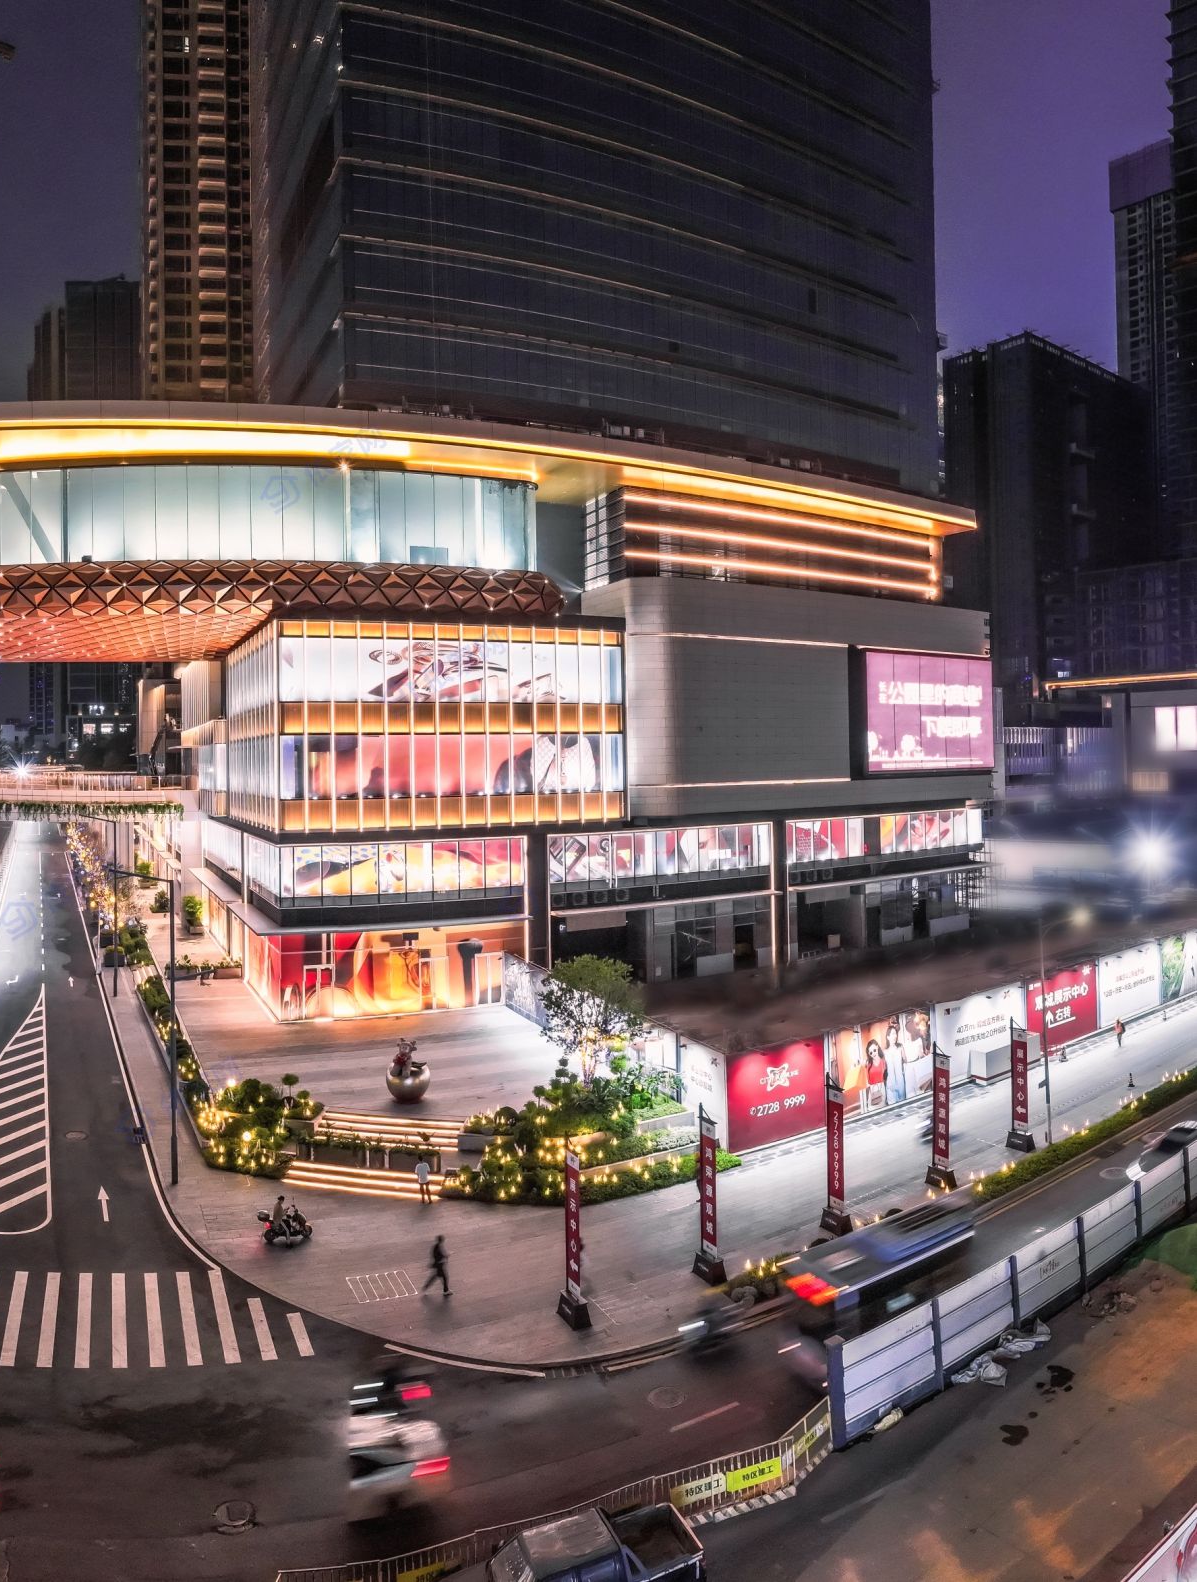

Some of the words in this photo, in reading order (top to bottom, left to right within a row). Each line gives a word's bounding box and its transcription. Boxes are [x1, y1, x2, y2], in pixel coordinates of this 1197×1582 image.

[1016, 1048, 1025, 1101] 展示中心
[757, 1101, 780, 1117] 2728
[783, 1093, 806, 1110] 9999
[742, 1464, 774, 1482] 特区建工
[684, 1477, 723, 1498] 特区建工
